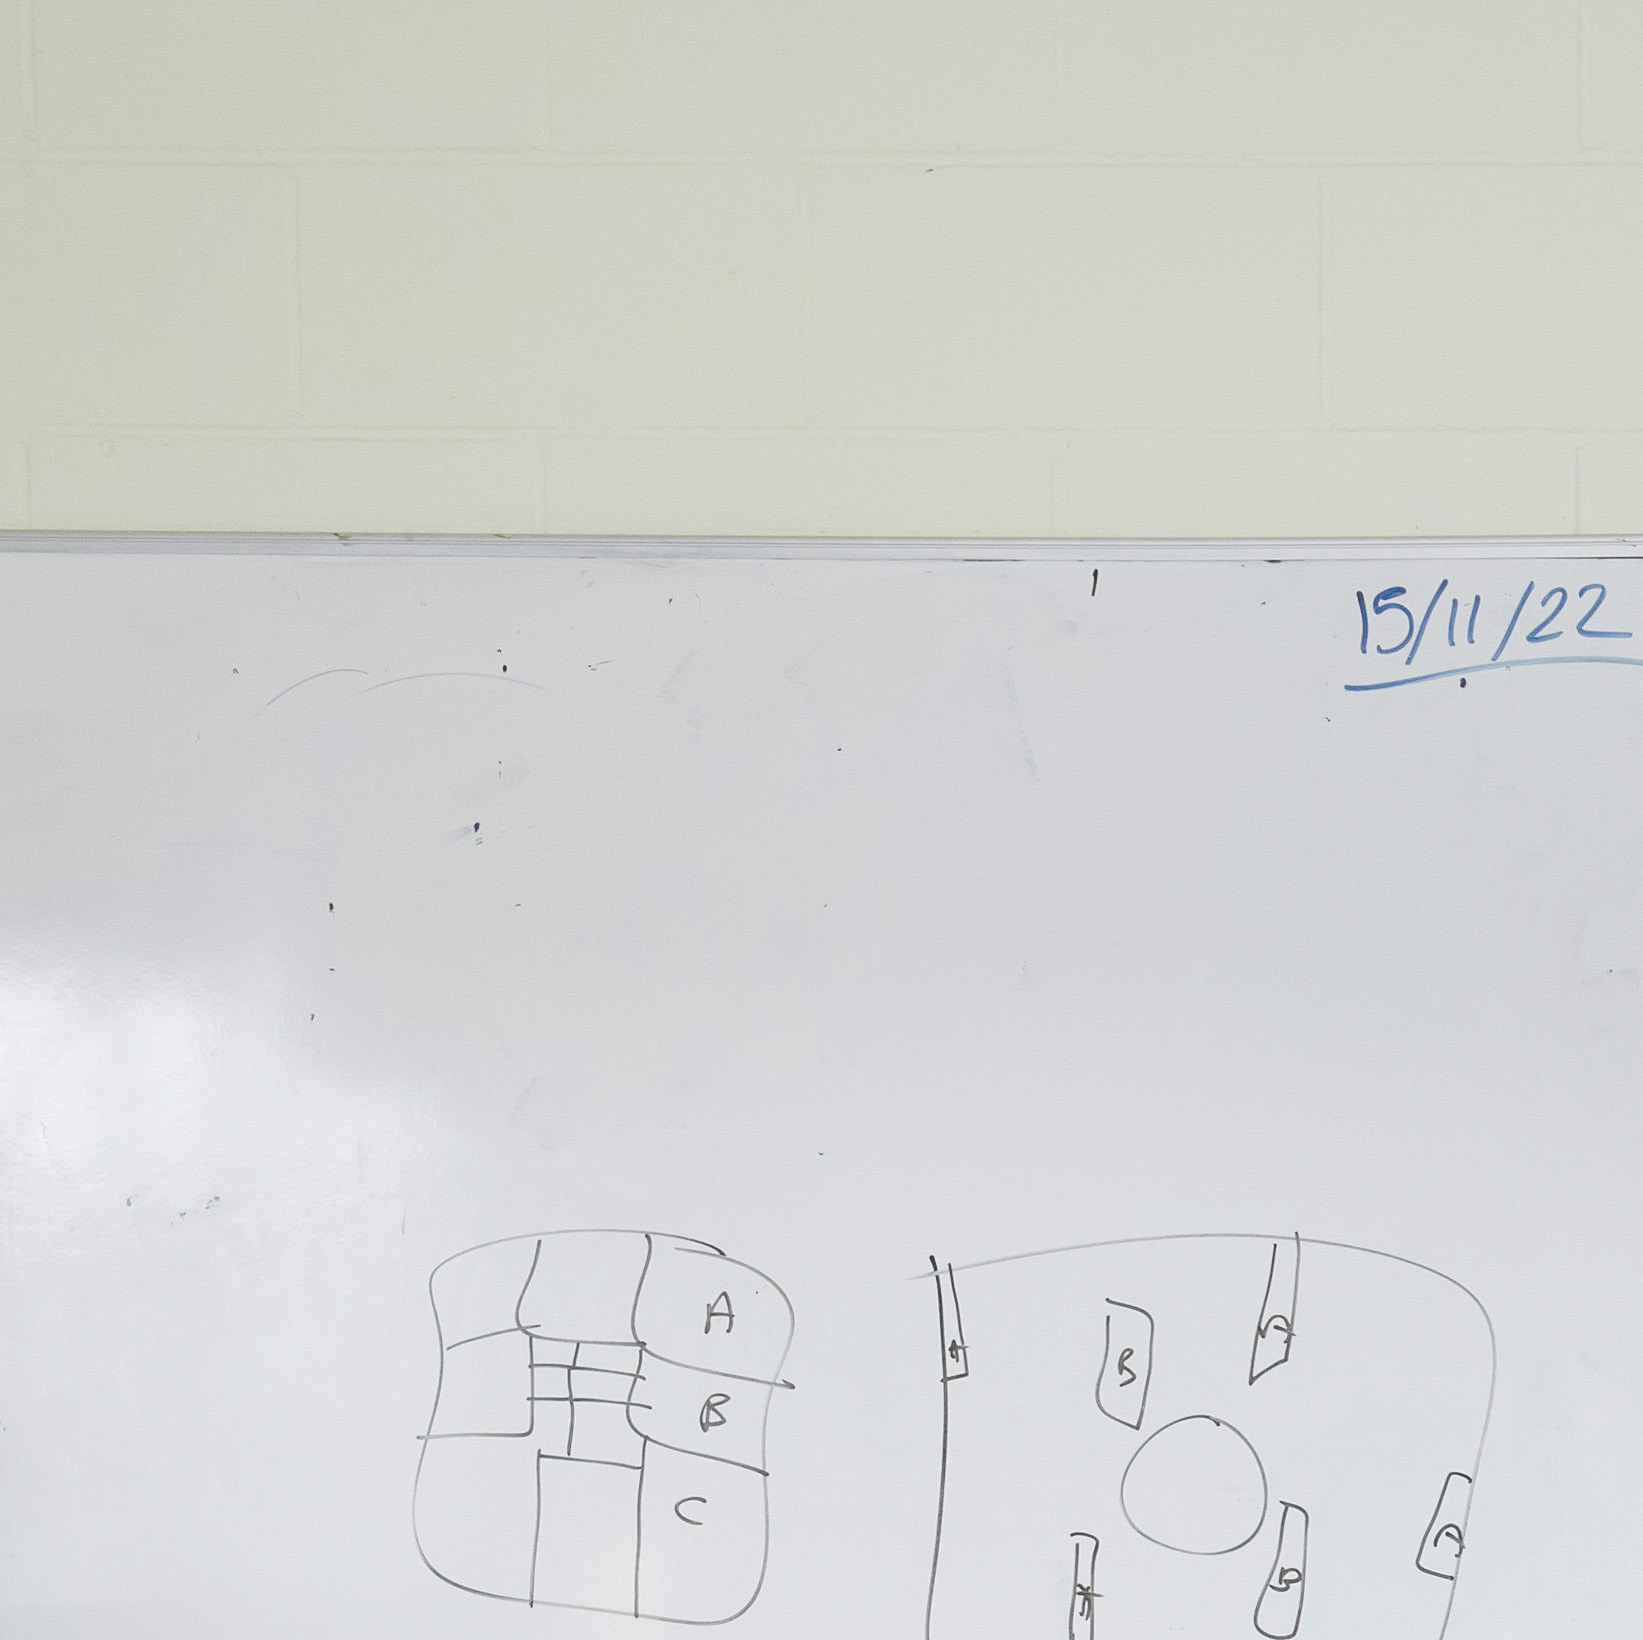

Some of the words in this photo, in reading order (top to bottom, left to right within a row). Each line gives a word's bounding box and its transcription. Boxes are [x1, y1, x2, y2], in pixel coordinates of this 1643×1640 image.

[1356, 579, 1633, 665] 15/11/22
[704, 1291, 735, 1335] A
[1116, 1348, 1138, 1387] B
[700, 1393, 732, 1433] B
[674, 1496, 707, 1526] C
